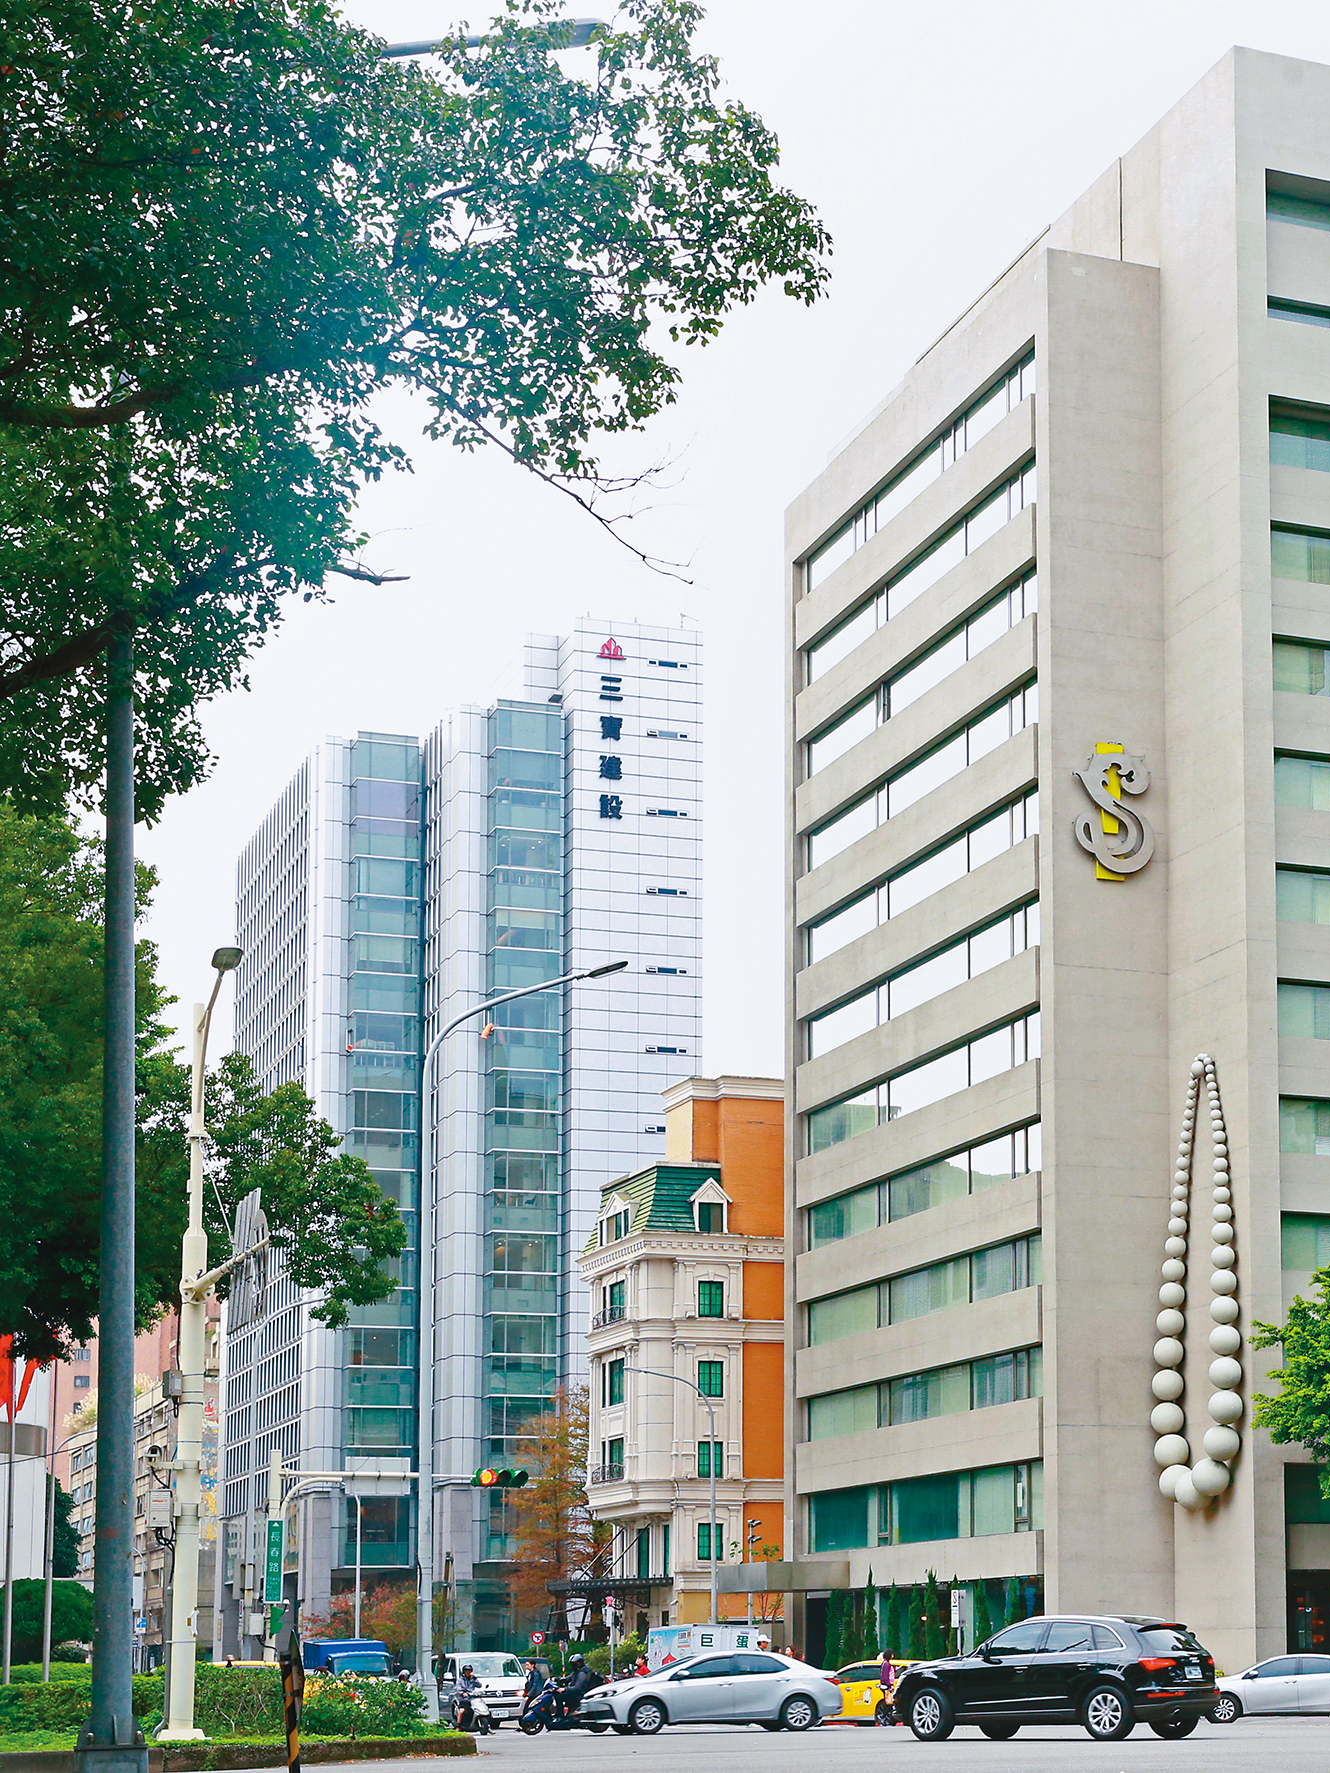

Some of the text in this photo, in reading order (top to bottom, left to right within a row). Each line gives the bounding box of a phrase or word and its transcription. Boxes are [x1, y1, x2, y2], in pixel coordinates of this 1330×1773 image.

[599, 675, 623, 820] 三寶建設
[269, 1531, 280, 1572] 長春路
[701, 1634, 749, 1648] 巨蛋
